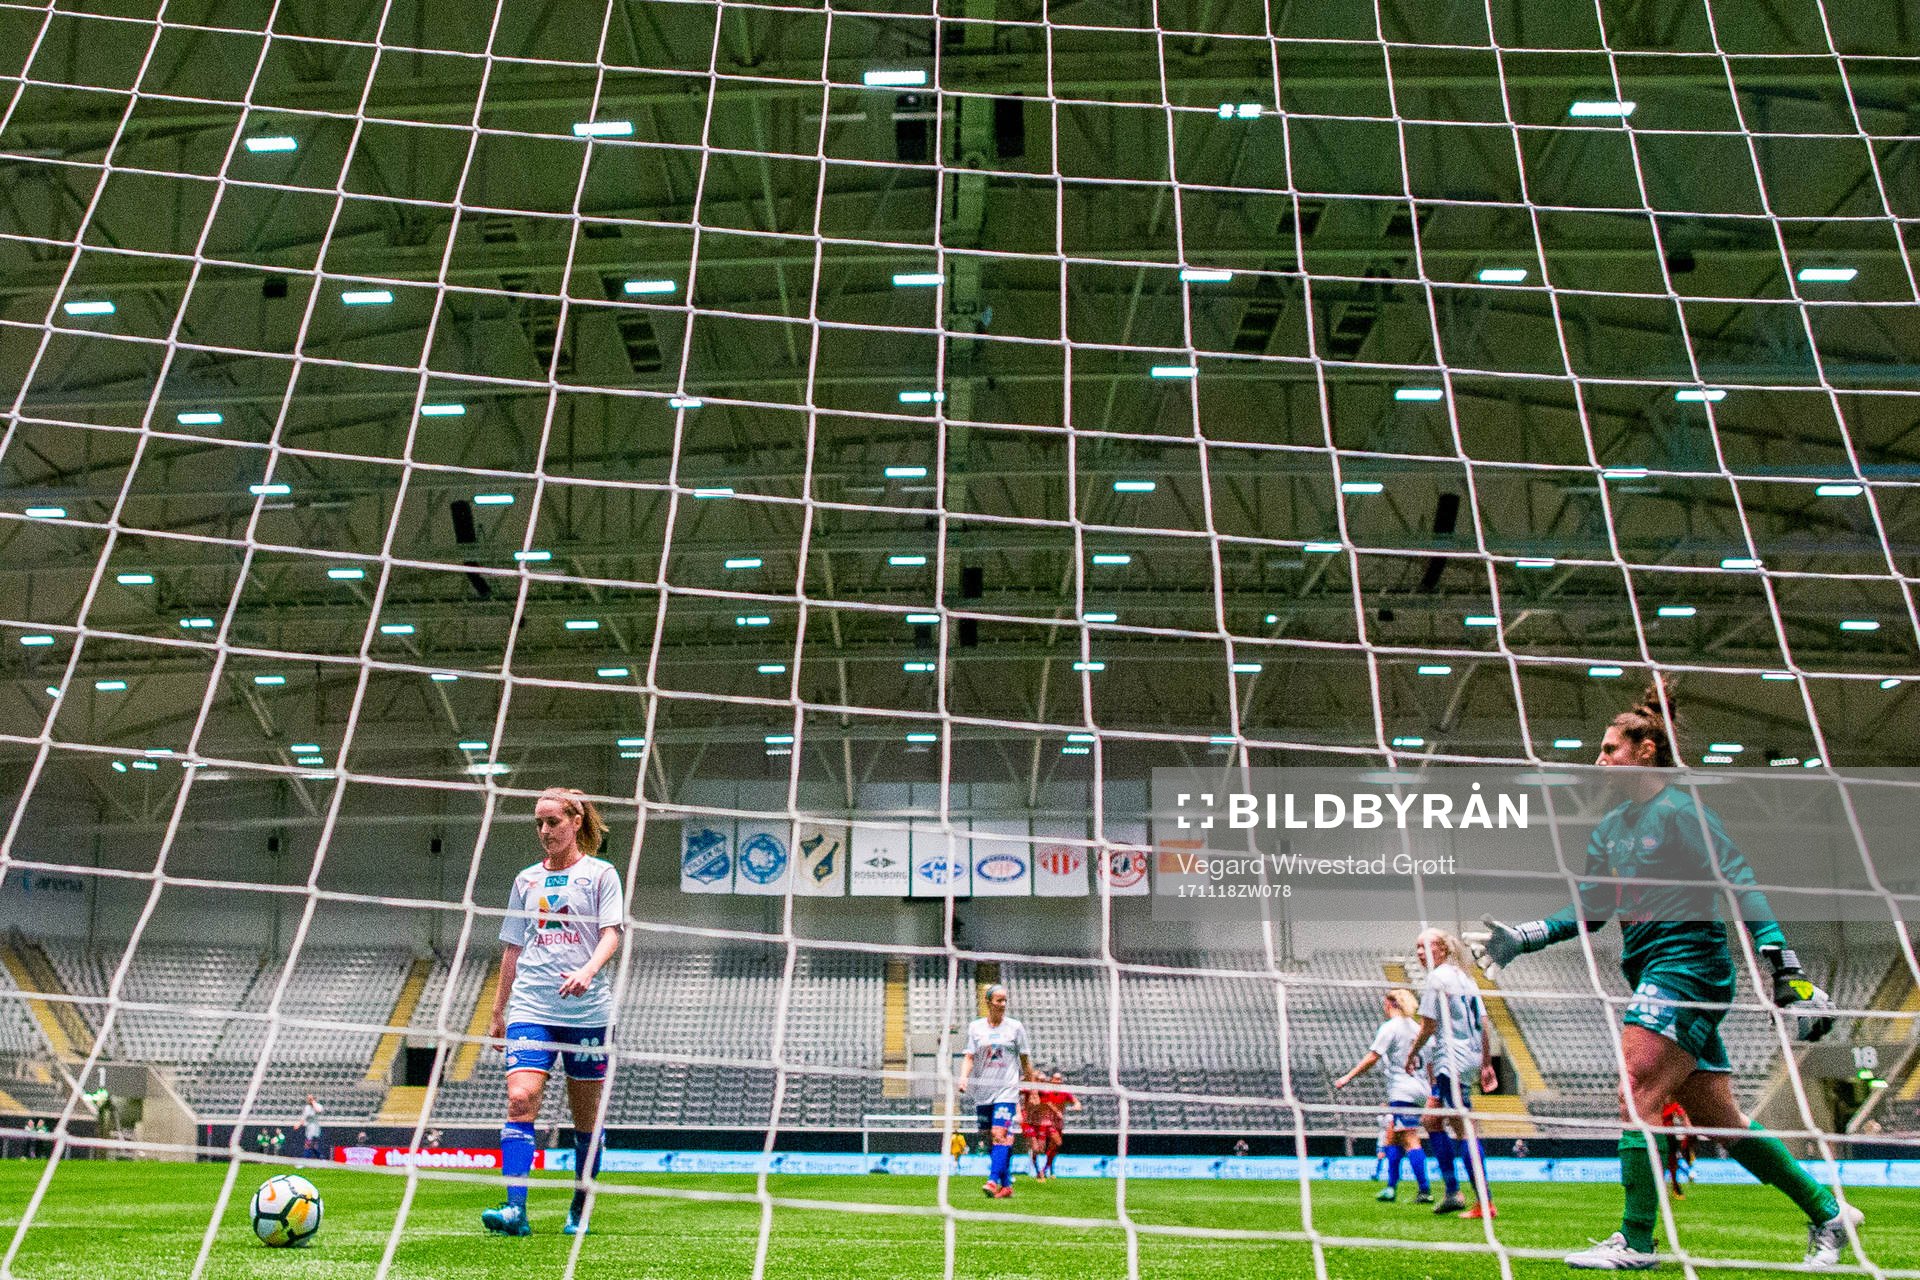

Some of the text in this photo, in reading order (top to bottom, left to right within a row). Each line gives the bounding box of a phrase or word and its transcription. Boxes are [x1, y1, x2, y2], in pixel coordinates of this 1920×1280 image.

[853, 871, 908, 880] ROSENBORG
[534, 931, 582, 947] ABONA
[1851, 1046, 1878, 1068] 18
